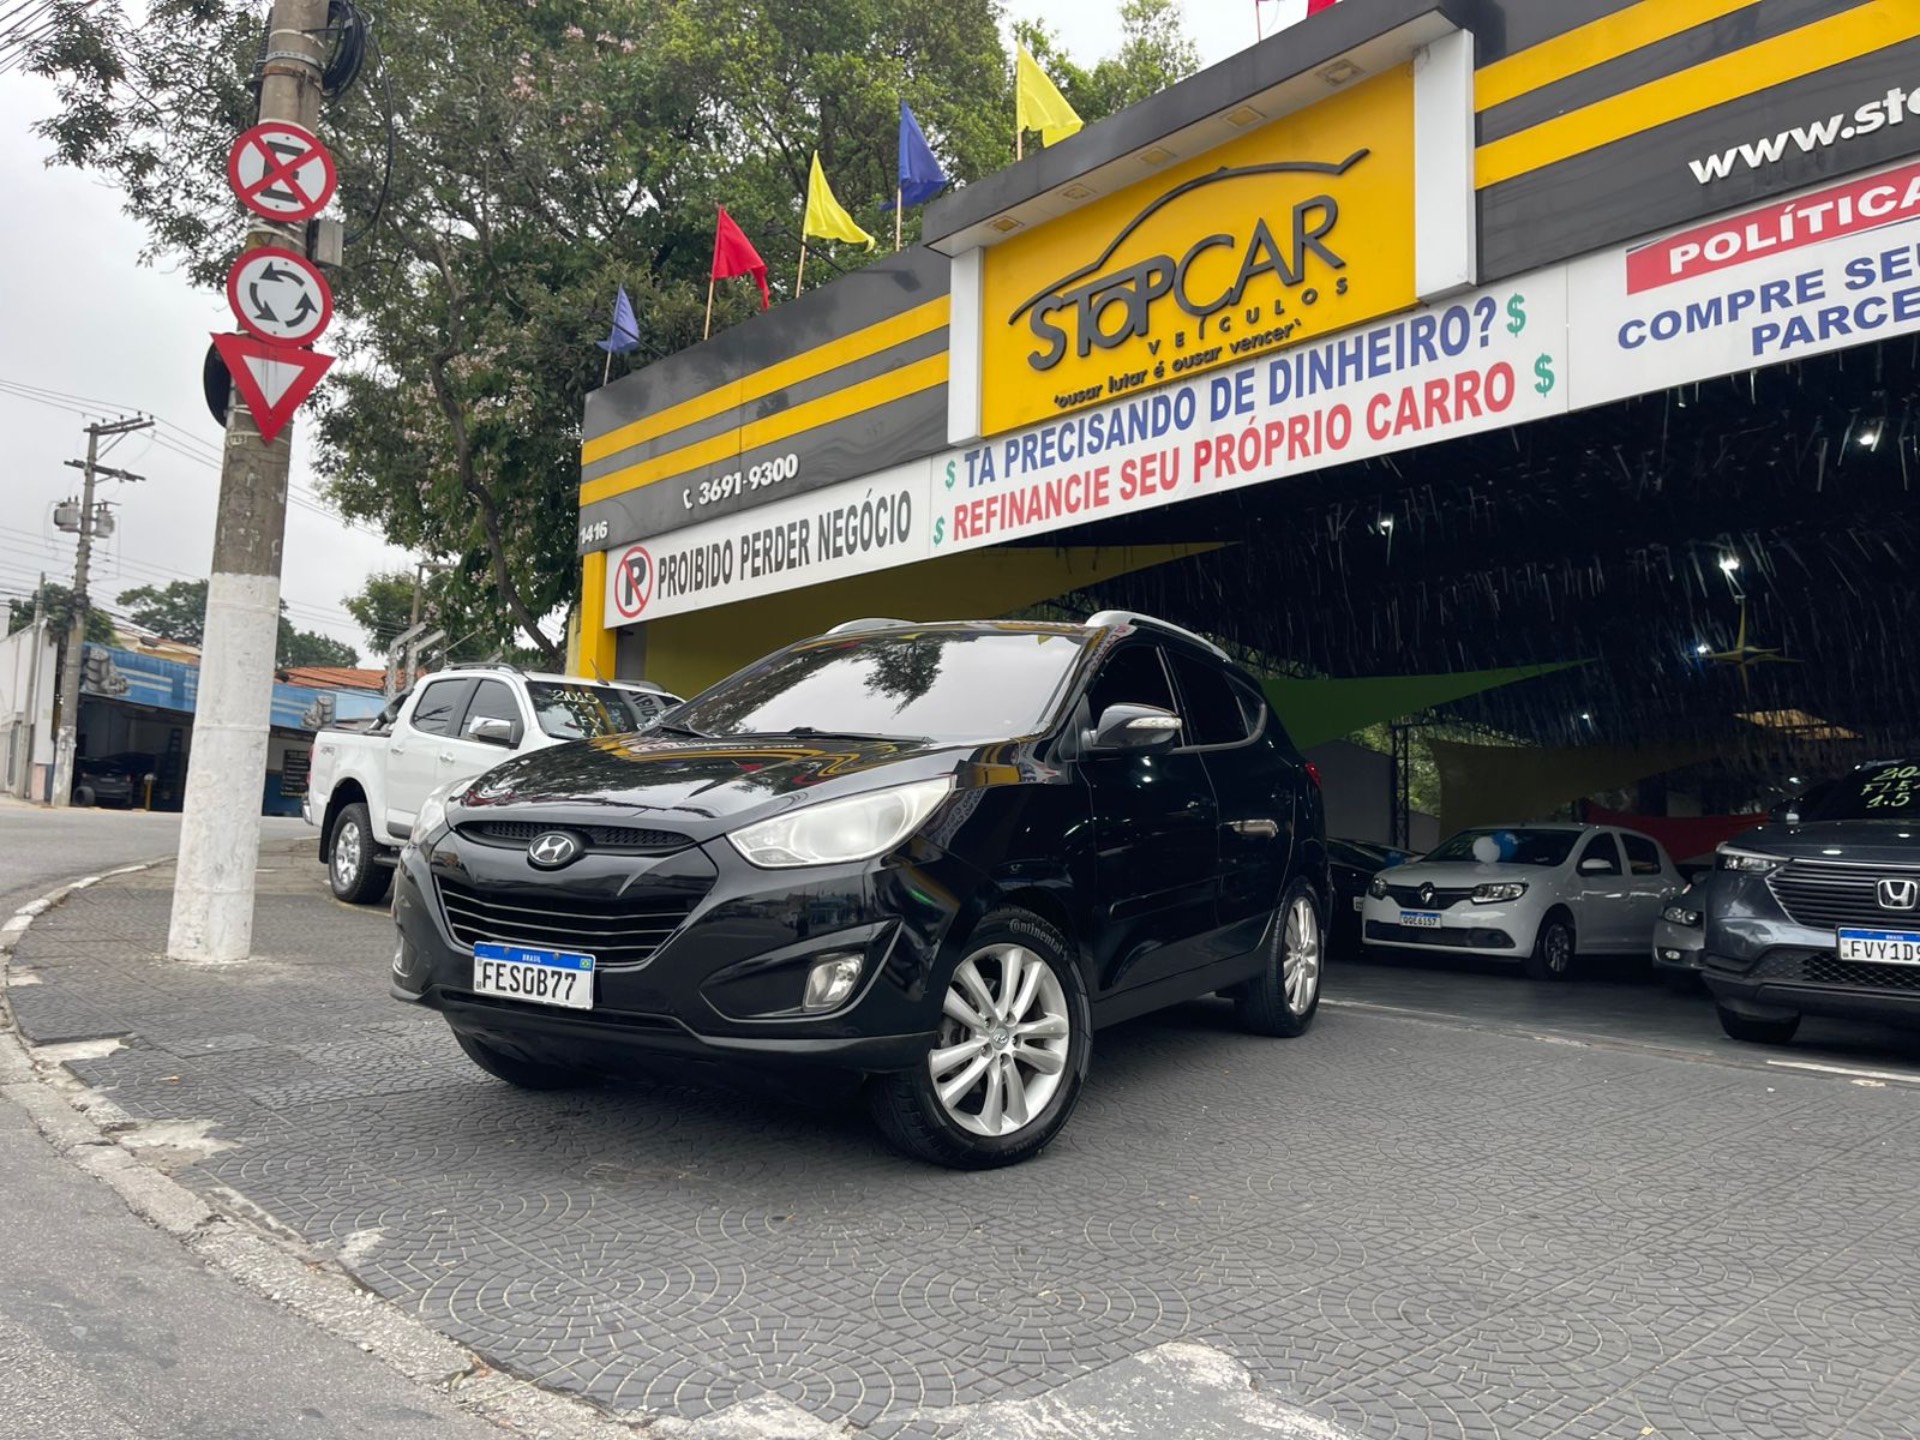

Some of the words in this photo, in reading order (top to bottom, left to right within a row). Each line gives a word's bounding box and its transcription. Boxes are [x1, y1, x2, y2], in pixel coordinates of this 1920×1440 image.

[1618, 268, 1825, 349] COMPRE
[1844, 243, 1920, 290] SE
[965, 446, 996, 488] TA
[1004, 386, 1196, 478] PRECISANDO
[1210, 368, 1255, 422] DE
[1269, 296, 1496, 406] DINHEIRO?
[1109, 368, 1148, 391] lutar
[1154, 361, 1164, 378] é
[1172, 347, 1221, 371] ousar
[699, 454, 798, 505] 3691-9300
[953, 466, 1110, 541] REFINANCIE
[1120, 447, 1180, 500] SEU
[1193, 403, 1352, 483] PRÓPRIO
[1366, 361, 1515, 441] CARRO
[580, 521, 608, 544] 1416
[657, 539, 733, 599] PROIBIDO
[740, 518, 810, 581] PERDER
[818, 489, 912, 562] NEGÓCIO
